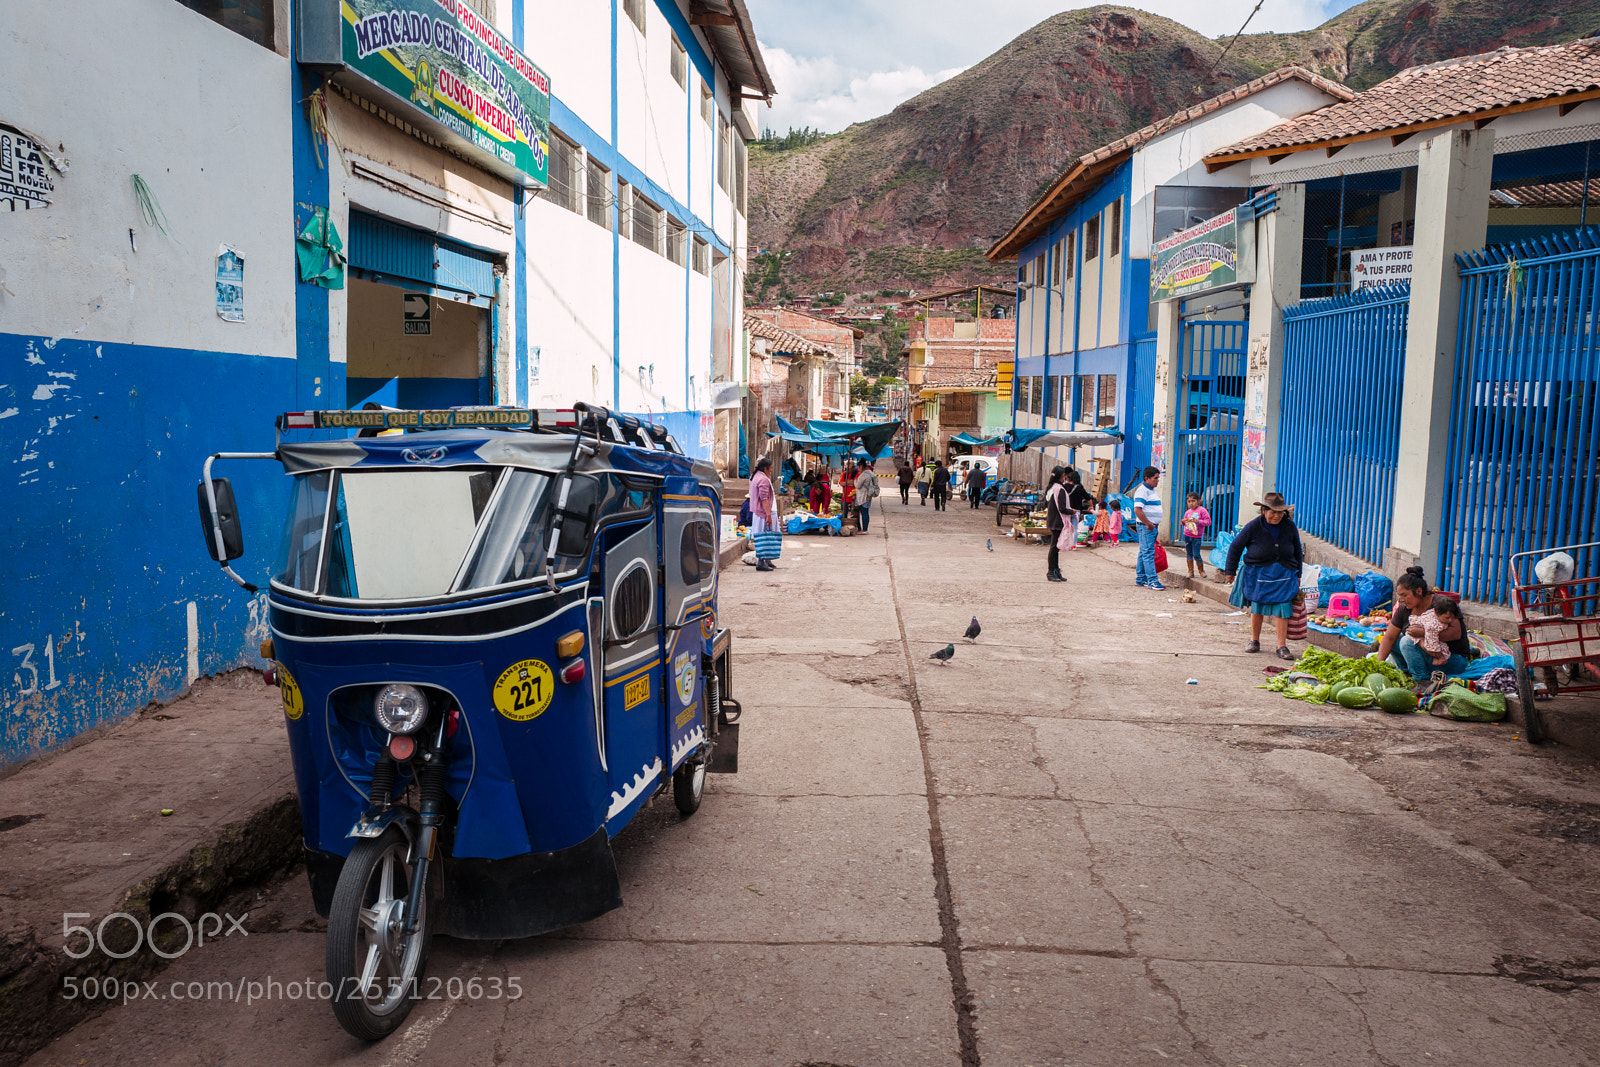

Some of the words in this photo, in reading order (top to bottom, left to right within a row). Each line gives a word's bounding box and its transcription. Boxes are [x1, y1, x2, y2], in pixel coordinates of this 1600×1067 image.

[457, 2, 503, 57] PROVINCIAL
[505, 45, 514, 65] DE
[515, 51, 549, 95] URUBAMBA
[354, 12, 432, 57] MERCADO
[433, 20, 490, 81] CENTRAL
[491, 63, 505, 99] DE
[505, 86, 544, 169] ABASTOS
[439, 68, 474, 112] CUSCO
[475, 94, 517, 141] IMPERIAL
[438, 107, 472, 140] COOPERATIVA
[472, 128, 478, 144] DE
[15, 147, 43, 165] LA
[1360, 253, 1377, 263] AMA
[1378, 252, 1385, 262] Y
[1385, 250, 1413, 261] PROTE
[1175, 268, 1190, 282] CUSCO
[1189, 261, 1211, 278] IMPERIAL
[1362, 267, 1368, 276] A
[1369, 265, 1384, 275] TUS
[1359, 278, 1387, 289] TENLOS
[405, 322, 429, 334] SALIDA
[323, 412, 384, 427] TOCAME
[387, 412, 419, 427] QUE
[422, 411, 452, 426] SOY
[453, 410, 531, 426] REALIDAD
[496, 660, 549, 689] TRANSVEMEMA
[510, 675, 542, 711] 227
